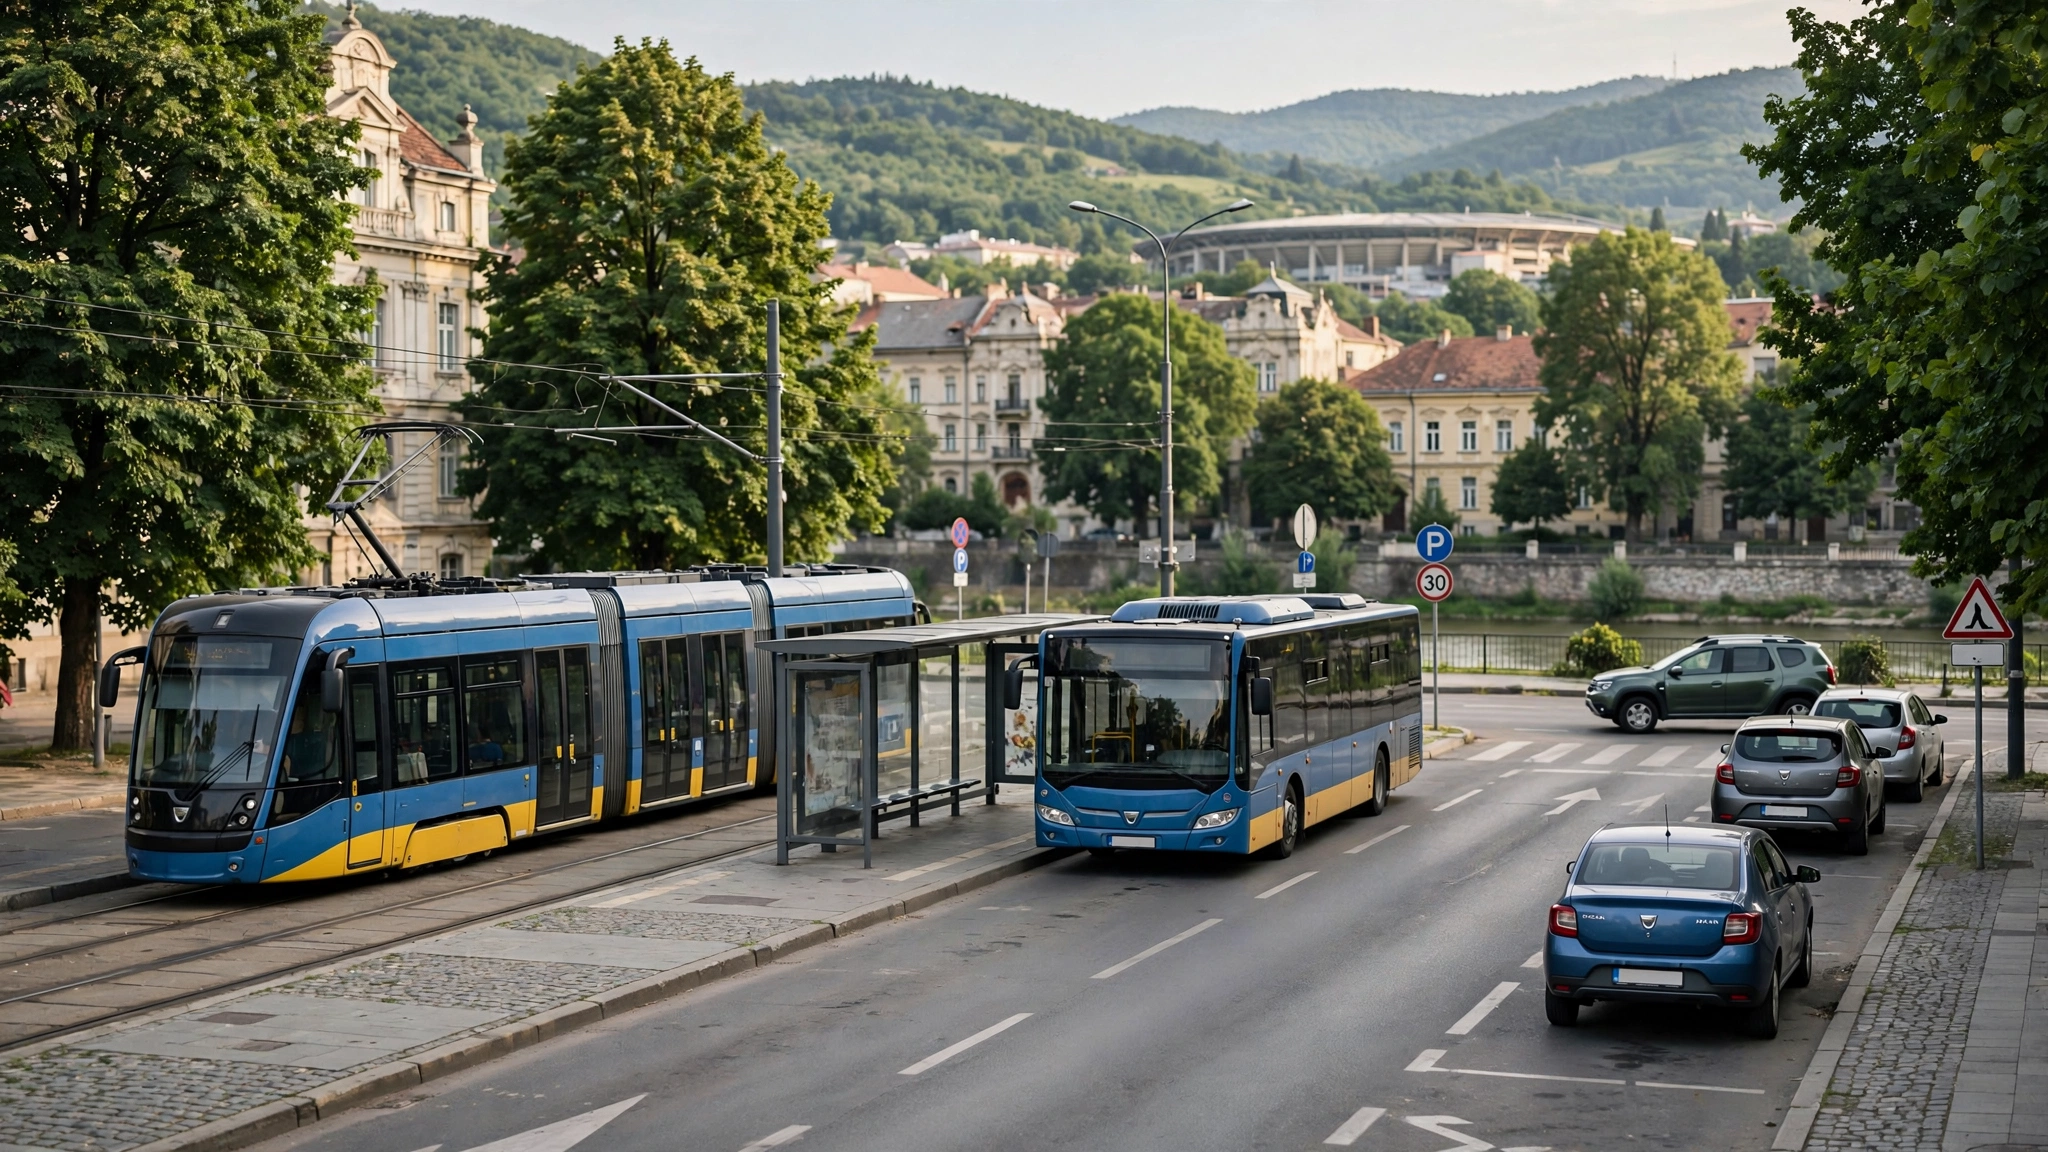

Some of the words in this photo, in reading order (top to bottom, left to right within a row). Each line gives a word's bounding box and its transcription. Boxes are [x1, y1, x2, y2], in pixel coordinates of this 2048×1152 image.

[1427, 532, 1445, 556] P
[958, 552, 965, 570] P
[1424, 575, 1446, 591] 30
